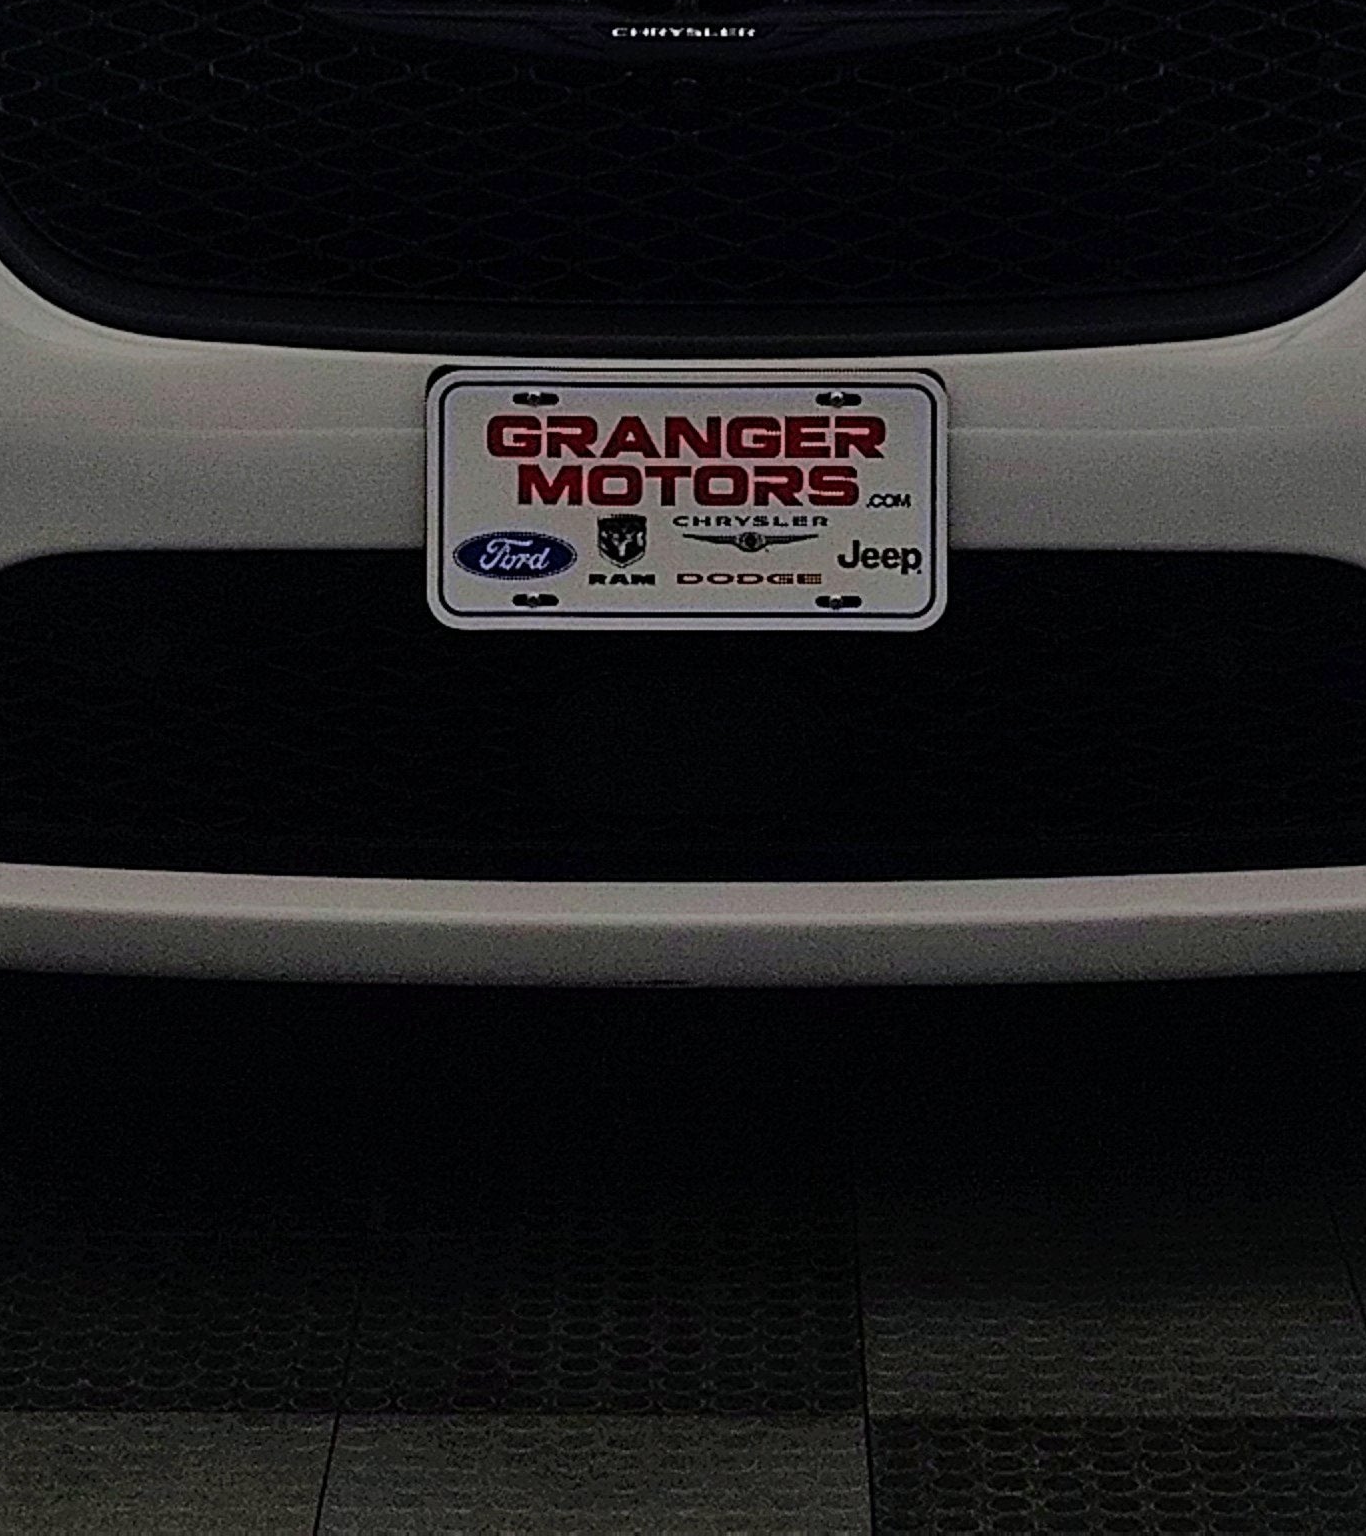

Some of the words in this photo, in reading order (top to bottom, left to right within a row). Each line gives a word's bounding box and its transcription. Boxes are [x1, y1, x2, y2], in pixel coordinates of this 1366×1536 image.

[611, 26, 756, 38] CHRYSLER
[486, 415, 886, 459] GRANGER
[518, 464, 860, 507] MOTORS
[672, 515, 829, 527] CHRYSLER
[478, 538, 551, 571] Ford
[838, 540, 922, 574] Jeep
[588, 573, 656, 585] RAM
[676, 573, 823, 585] DODGE
